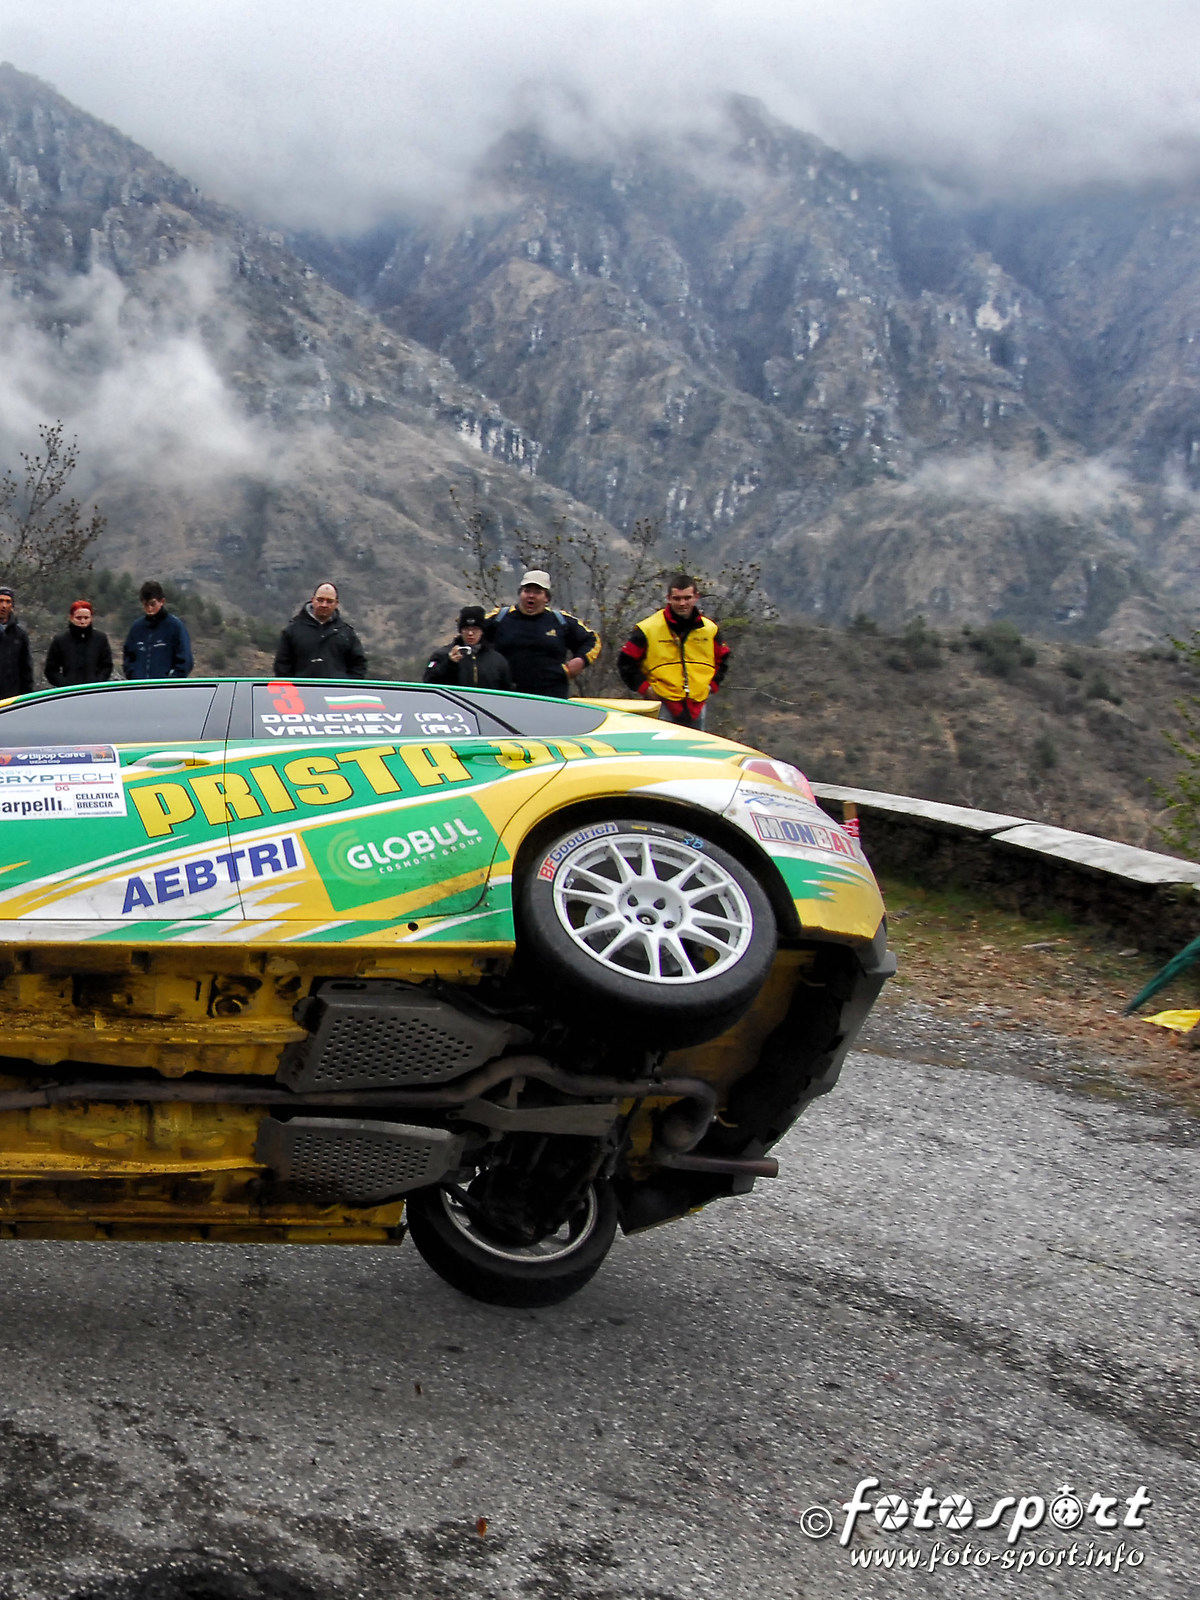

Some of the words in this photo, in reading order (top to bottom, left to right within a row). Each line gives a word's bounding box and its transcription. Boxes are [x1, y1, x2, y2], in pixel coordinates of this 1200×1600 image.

[266, 680, 305, 714] 3
[260, 713, 403, 723] DONCHEV
[264, 724, 404, 735] VALCHEV
[75, 792, 120, 800] CELLATICA
[77, 801, 114, 809] BRESCIA
[128, 742, 474, 839] PRISTA
[347, 818, 478, 869] GLOBUL
[379, 853, 437, 874] COSMOTE
[442, 836, 483, 856] GROUP
[121, 837, 298, 915] AEBTRI
